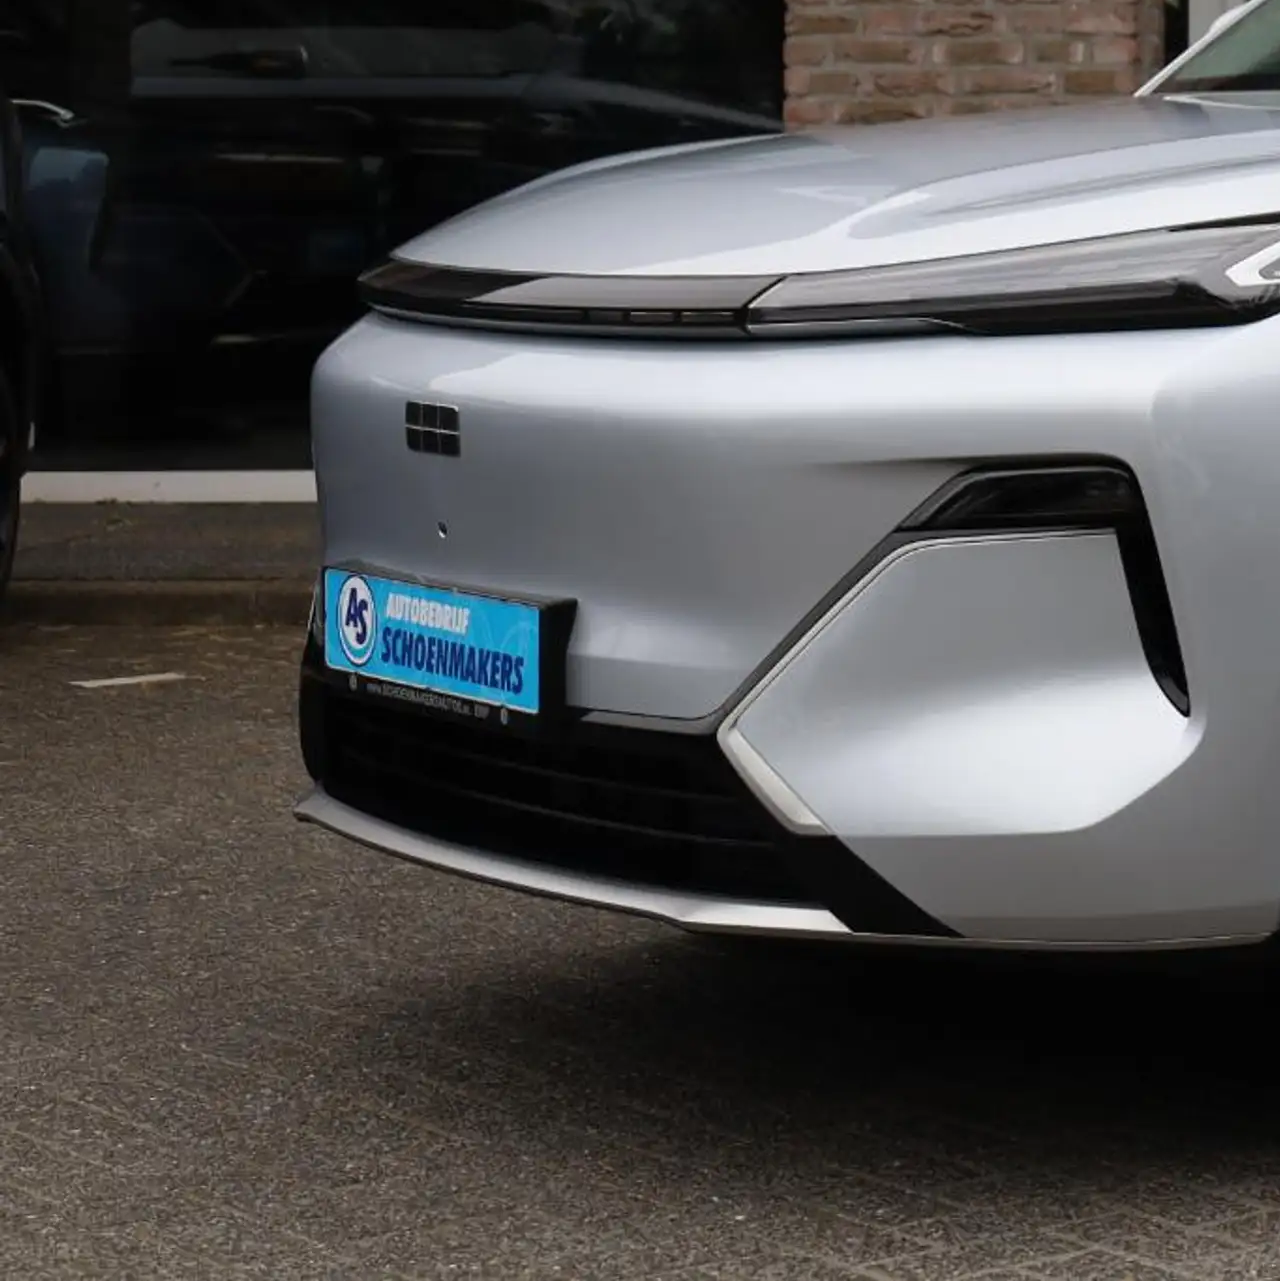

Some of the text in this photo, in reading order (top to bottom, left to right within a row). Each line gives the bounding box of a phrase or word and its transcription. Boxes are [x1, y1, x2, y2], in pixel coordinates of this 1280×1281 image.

[345, 587, 369, 645] AS
[386, 592, 470, 636] AUTOBEDRIJF
[380, 626, 524, 695] SCHOENMAKERS
